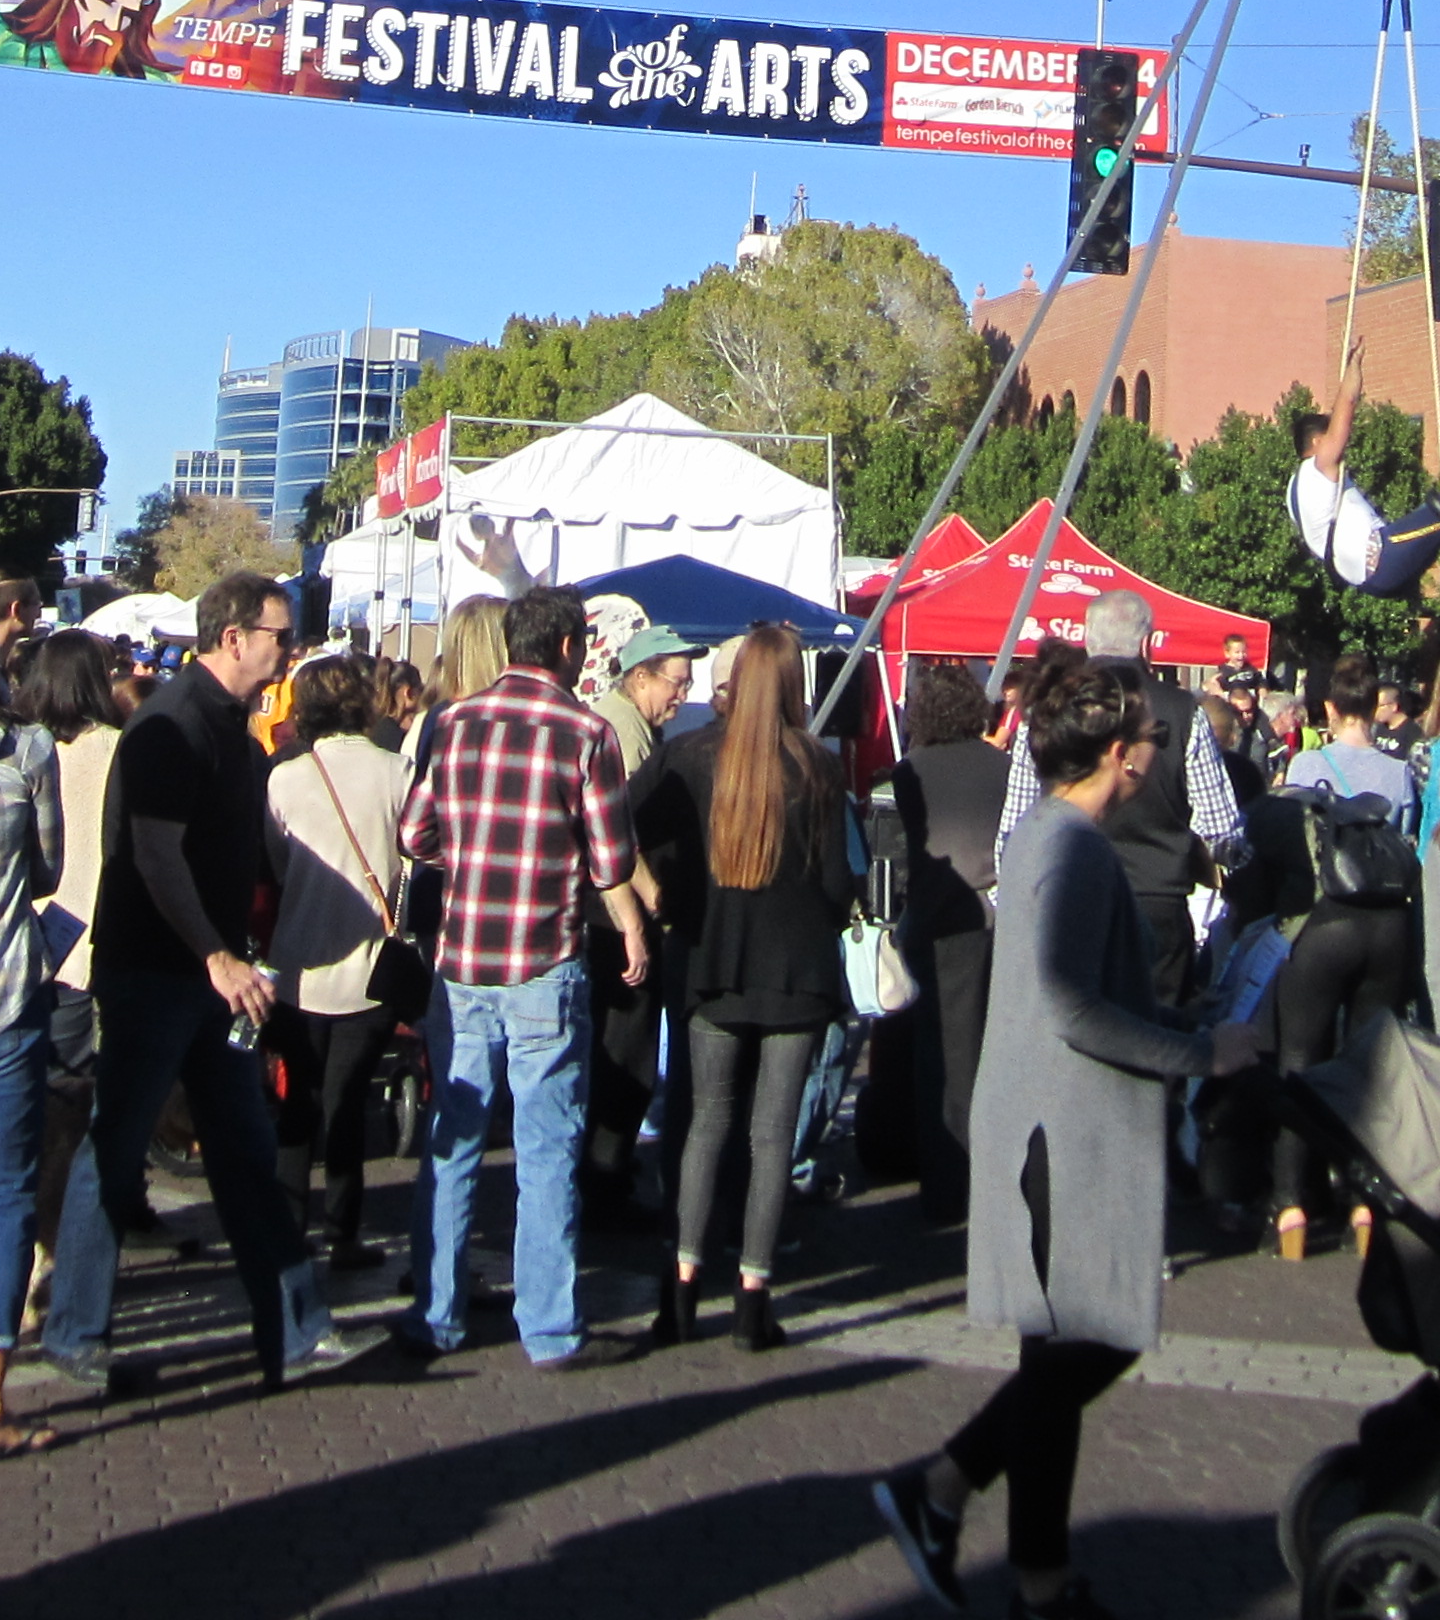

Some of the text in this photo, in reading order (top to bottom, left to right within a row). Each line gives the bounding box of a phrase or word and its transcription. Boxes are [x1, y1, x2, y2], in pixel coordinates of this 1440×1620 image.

[174, 16, 276, 48] TEMPE
[643, 23, 689, 70] of
[701, 39, 871, 126] ARTS
[910, 97, 959, 109] State Farm
[1008, 553, 1062, 571] Stte
[1063, 559, 1114, 577] Farm
[1049, 617, 1089, 642] Sta
